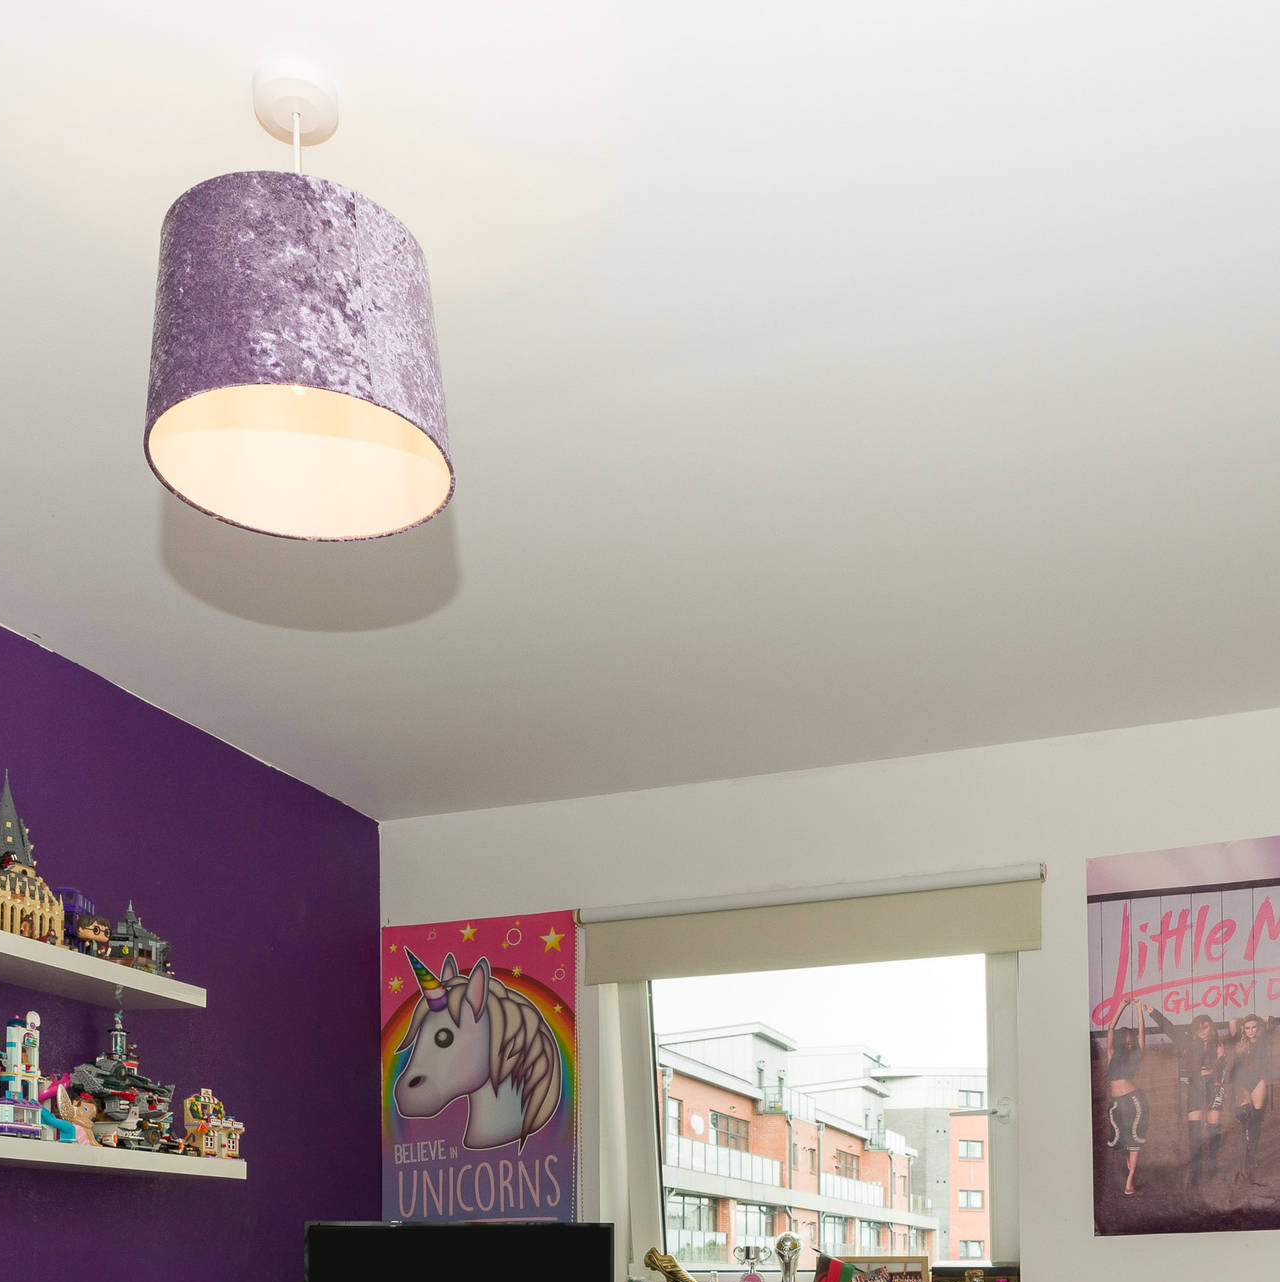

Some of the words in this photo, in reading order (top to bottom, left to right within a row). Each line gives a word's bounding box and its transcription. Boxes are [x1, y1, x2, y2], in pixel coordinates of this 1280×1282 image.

[1092, 902, 1236, 1025] Little
[1163, 981, 1256, 1014] GLORY
[394, 1139, 447, 1165] BELIEVE
[450, 1146, 458, 1159] IN
[398, 1155, 561, 1218] UNICORNS
